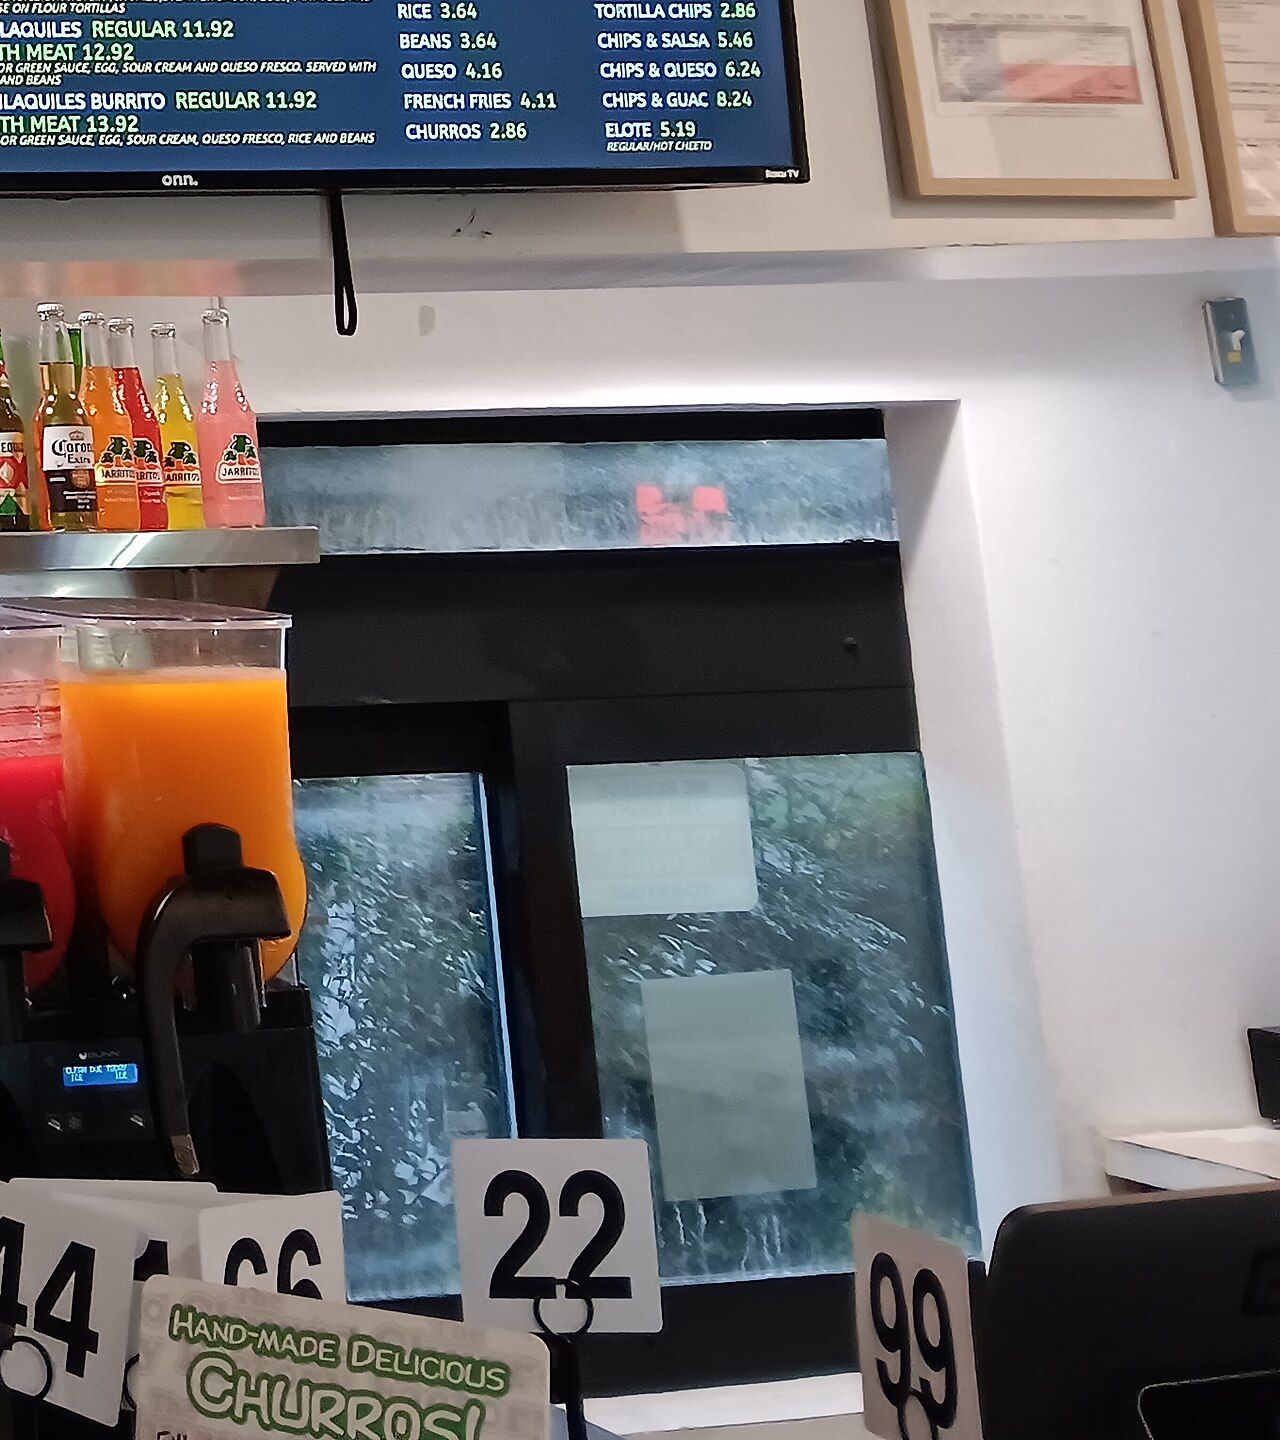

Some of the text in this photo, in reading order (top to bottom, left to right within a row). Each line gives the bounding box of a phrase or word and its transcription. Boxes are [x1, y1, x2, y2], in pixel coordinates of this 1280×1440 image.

[398, 3, 477, 19] RICE 3.64
[594, 3, 755, 18] TORTILLA CHIPS 2.86
[484, 1170, 632, 1299] 22
[169, 1310, 506, 1391] HAND-MADE DELICIOUS
[870, 1252, 958, 1429] 99
